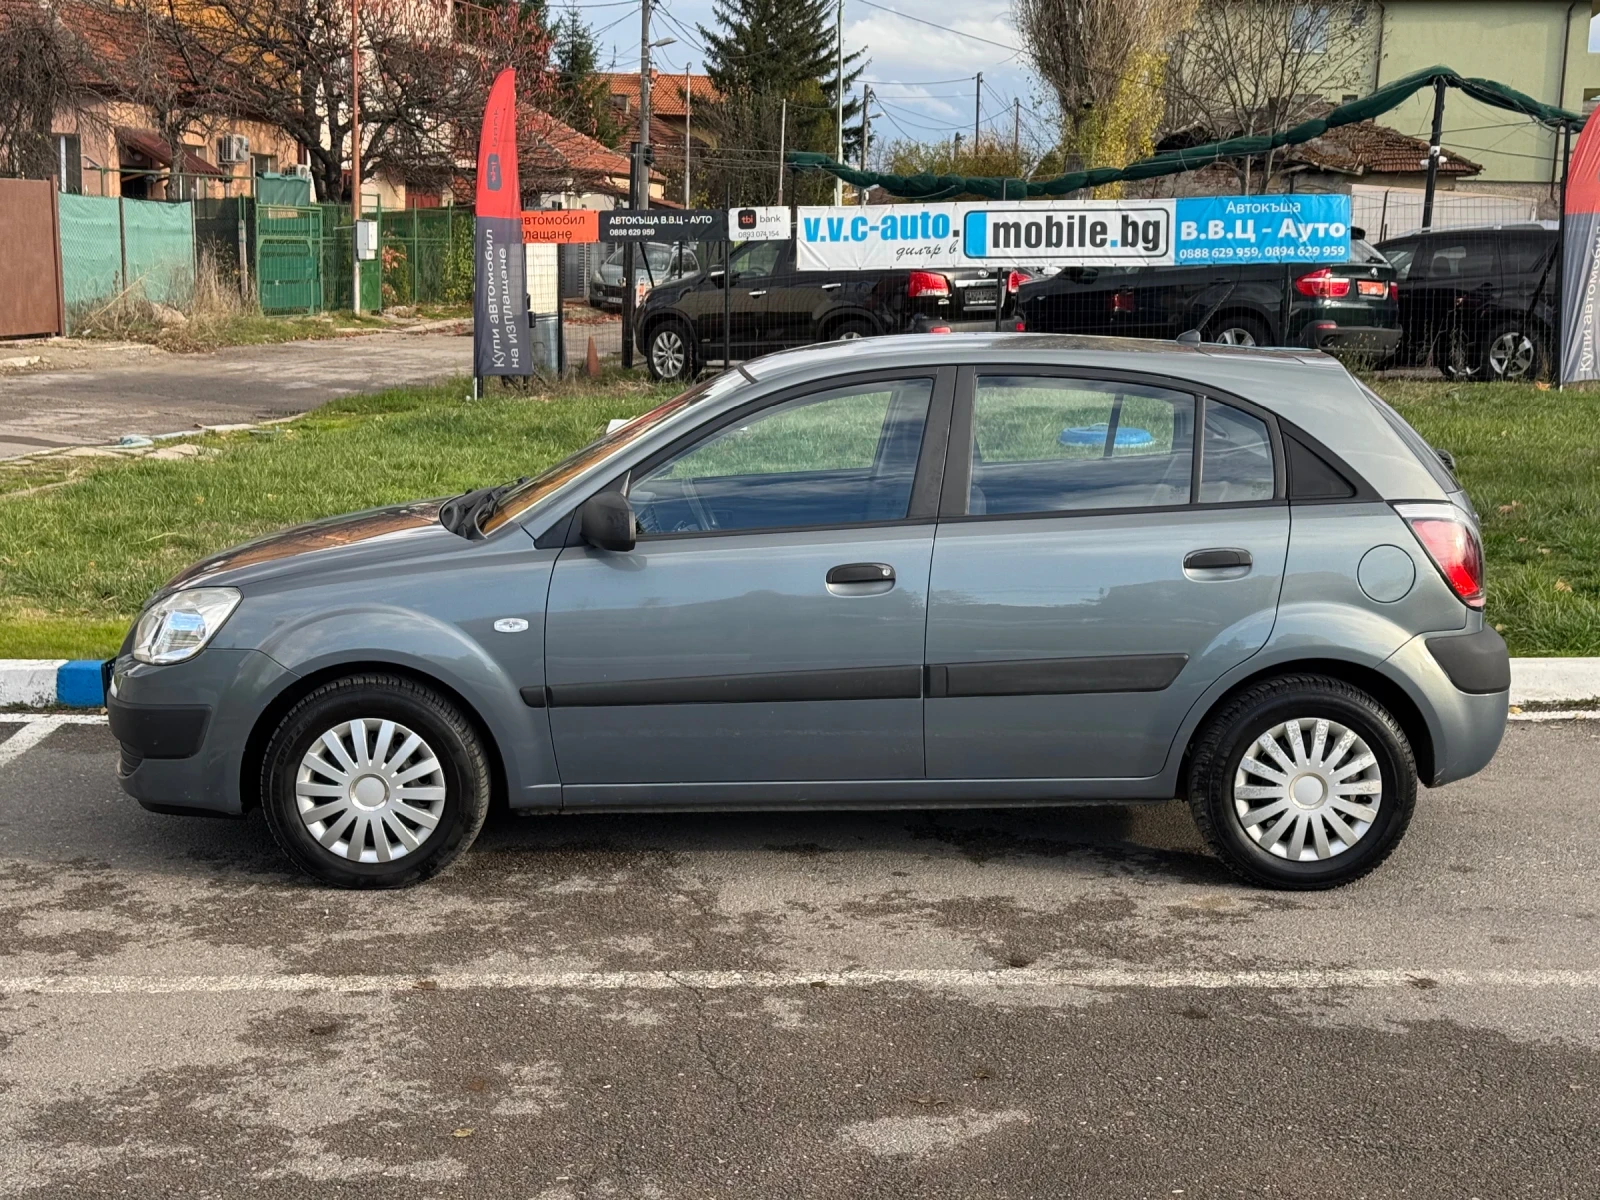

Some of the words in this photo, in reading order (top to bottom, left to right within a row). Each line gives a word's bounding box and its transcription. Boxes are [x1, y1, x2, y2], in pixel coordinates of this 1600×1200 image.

[741, 214, 754, 224] tbi
[760, 214, 781, 223] bank
[1225, 201, 1301, 214] Автокъща
[609, 216, 659, 226] АВТОКЪЩА
[660, 216, 684, 226] В.В.Ц
[690, 215, 713, 225] АУТО
[1180, 219, 1256, 243] В.В.Ц
[1278, 218, 1346, 243] Ауто
[738, 231, 755, 239] 0893
[756, 230, 767, 238] 074
[992, 215, 1160, 252] mobile.bg
[1179, 248, 1209, 259] 0888
[1211, 248, 1234, 258] 629
[1235, 247, 1262, 259] 959,
[1264, 246, 1295, 257] 0894
[1297, 246, 1320, 257] 629
[1322, 245, 1346, 256] 959
[485, 229, 500, 325] автомобил
[499, 247, 518, 343] изплащане
[492, 328, 507, 367] Купи
[510, 347, 520, 368] на
[1580, 329, 1594, 372] Купи
